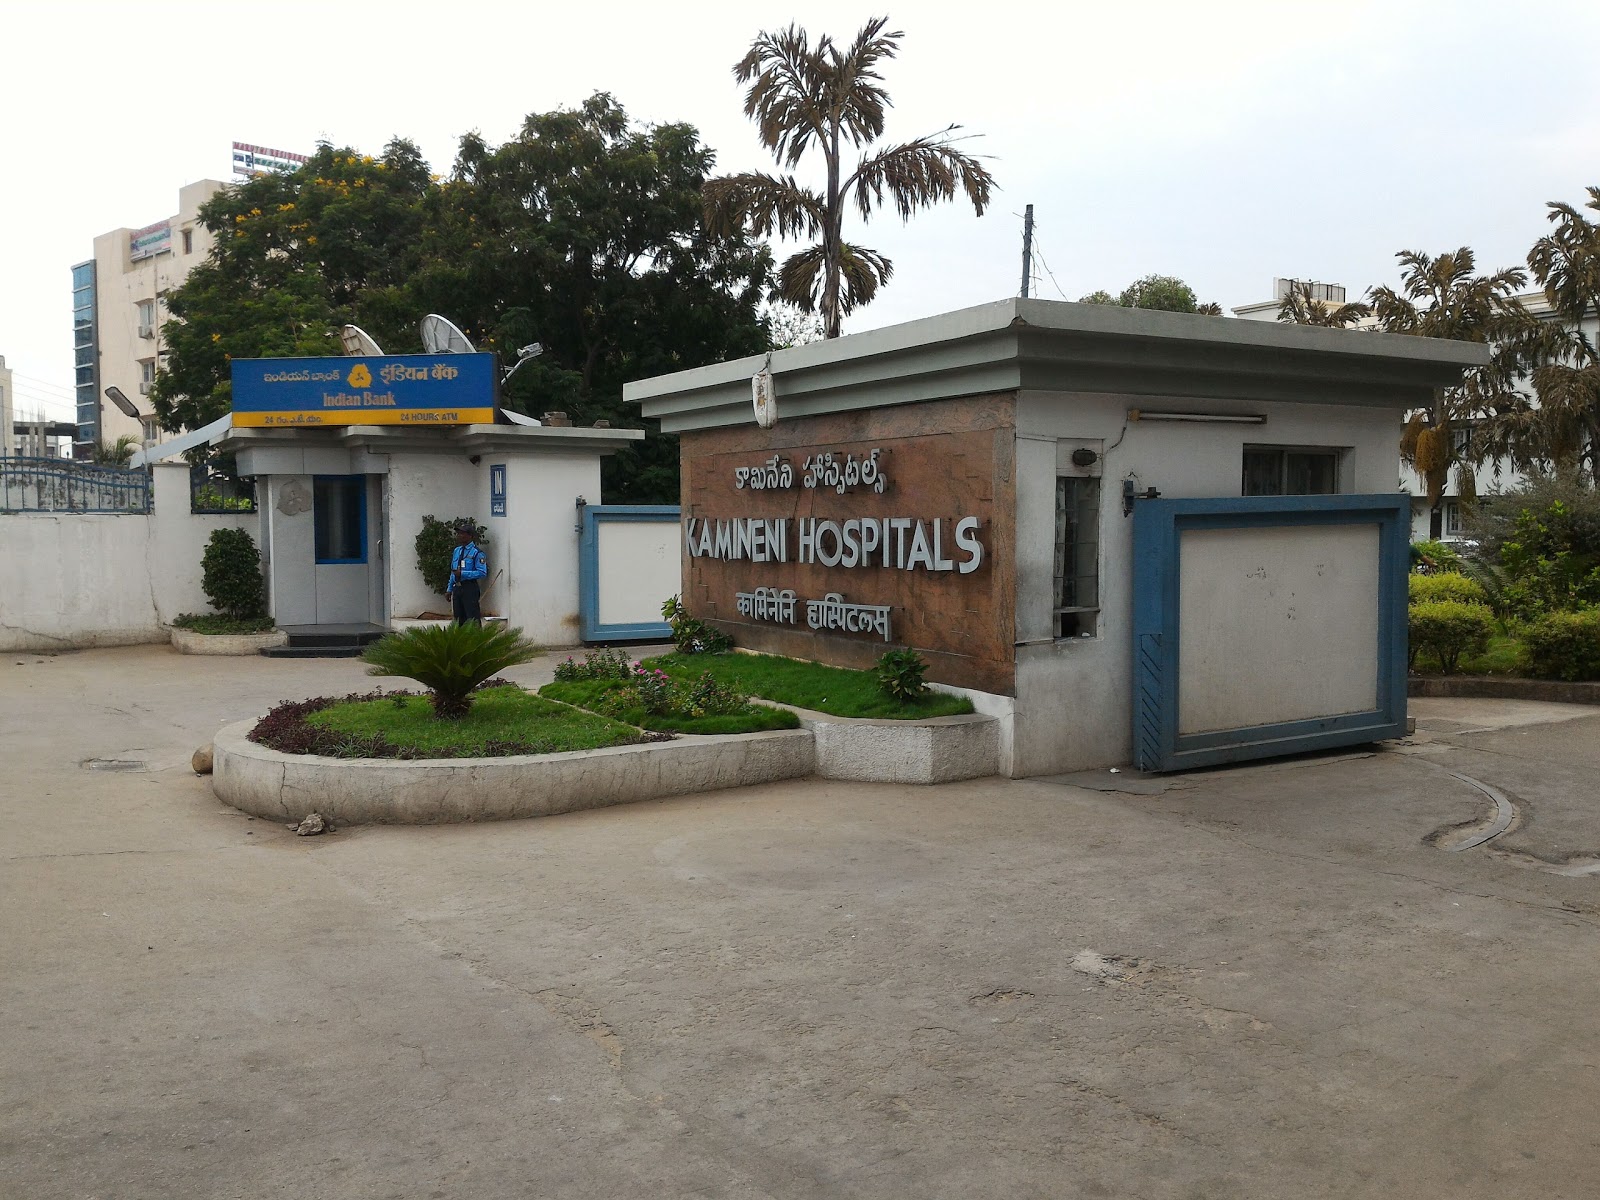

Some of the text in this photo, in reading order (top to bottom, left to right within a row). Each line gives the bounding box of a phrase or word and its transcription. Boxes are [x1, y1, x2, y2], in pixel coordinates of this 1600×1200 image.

[264, 370, 310, 382] ఇండియన్
[380, 363, 458, 385] इंडियन बैंक
[323, 391, 396, 407] Indian Bank
[400, 412, 458, 421] 24 HOURS ATM
[494, 470, 502, 494] IN
[735, 448, 887, 494] కామినేని హాస్పిటల్స్
[684, 516, 985, 574] KAMINENI HOSPITALS
[735, 587, 892, 642] कामिनेनि हास्पिटल्स
